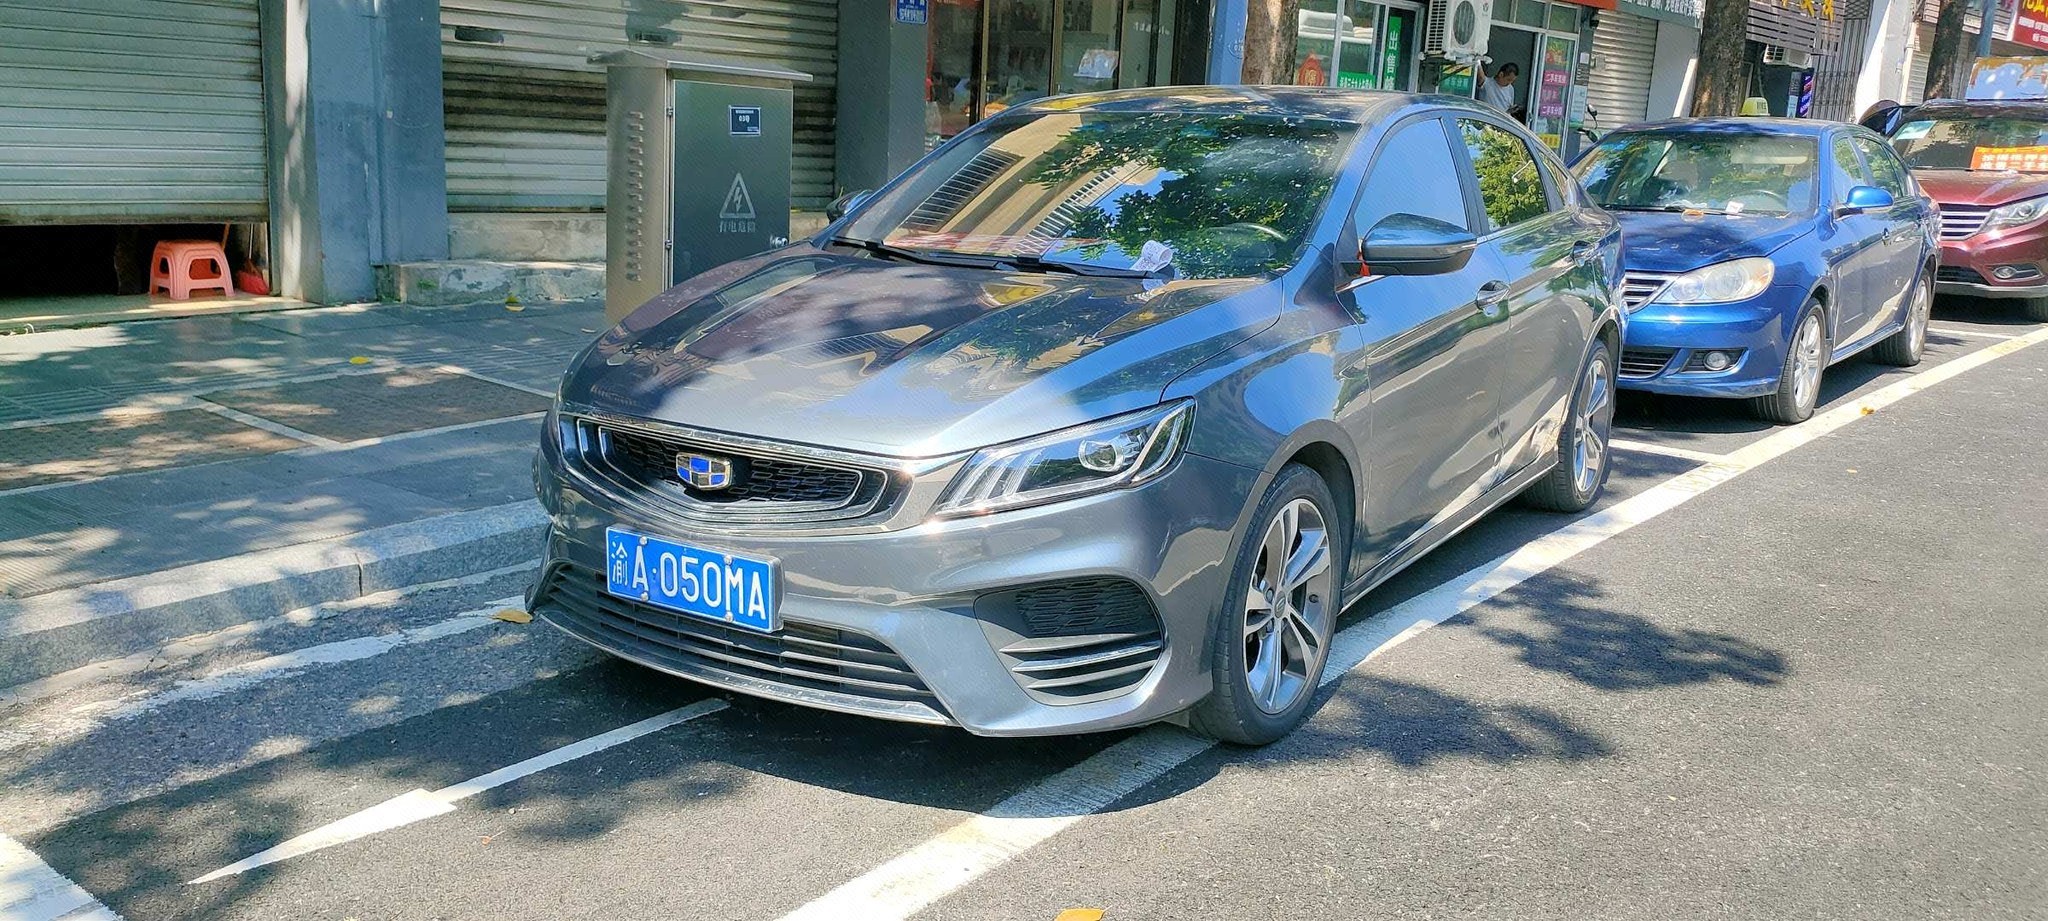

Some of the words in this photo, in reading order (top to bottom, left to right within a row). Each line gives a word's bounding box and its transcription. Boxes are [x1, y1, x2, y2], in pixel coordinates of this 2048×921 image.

[719, 220, 756, 233] 有电危险
[611, 541, 767, 620] 渝A·050MA
